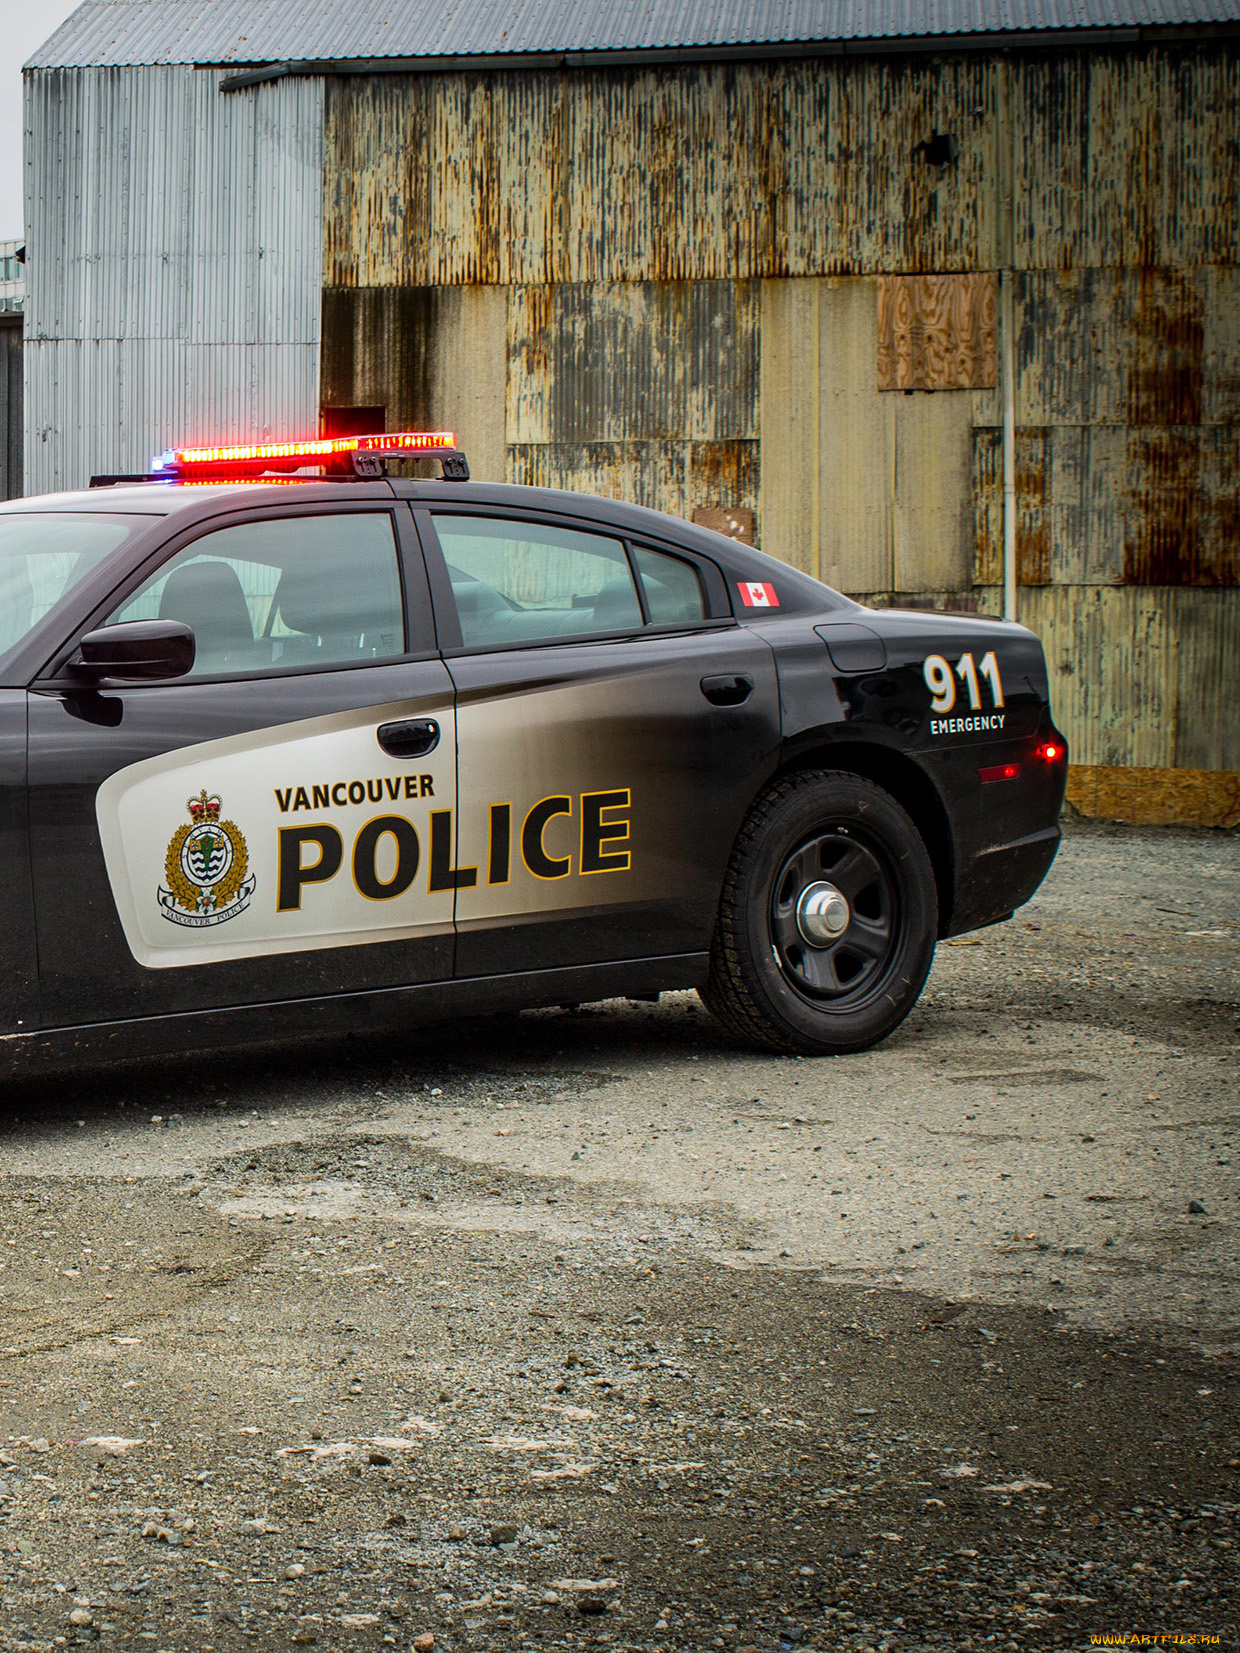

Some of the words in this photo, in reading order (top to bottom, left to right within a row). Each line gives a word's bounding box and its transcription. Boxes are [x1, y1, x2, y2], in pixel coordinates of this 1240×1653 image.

[923, 651, 1004, 714] 911
[930, 715, 1005, 735] EMERGENCY
[274, 773, 435, 813] VANCOUVER
[275, 787, 631, 913] POLICE
[166, 909, 210, 926] VANCOUVER
[217, 902, 245, 921] POLICE
